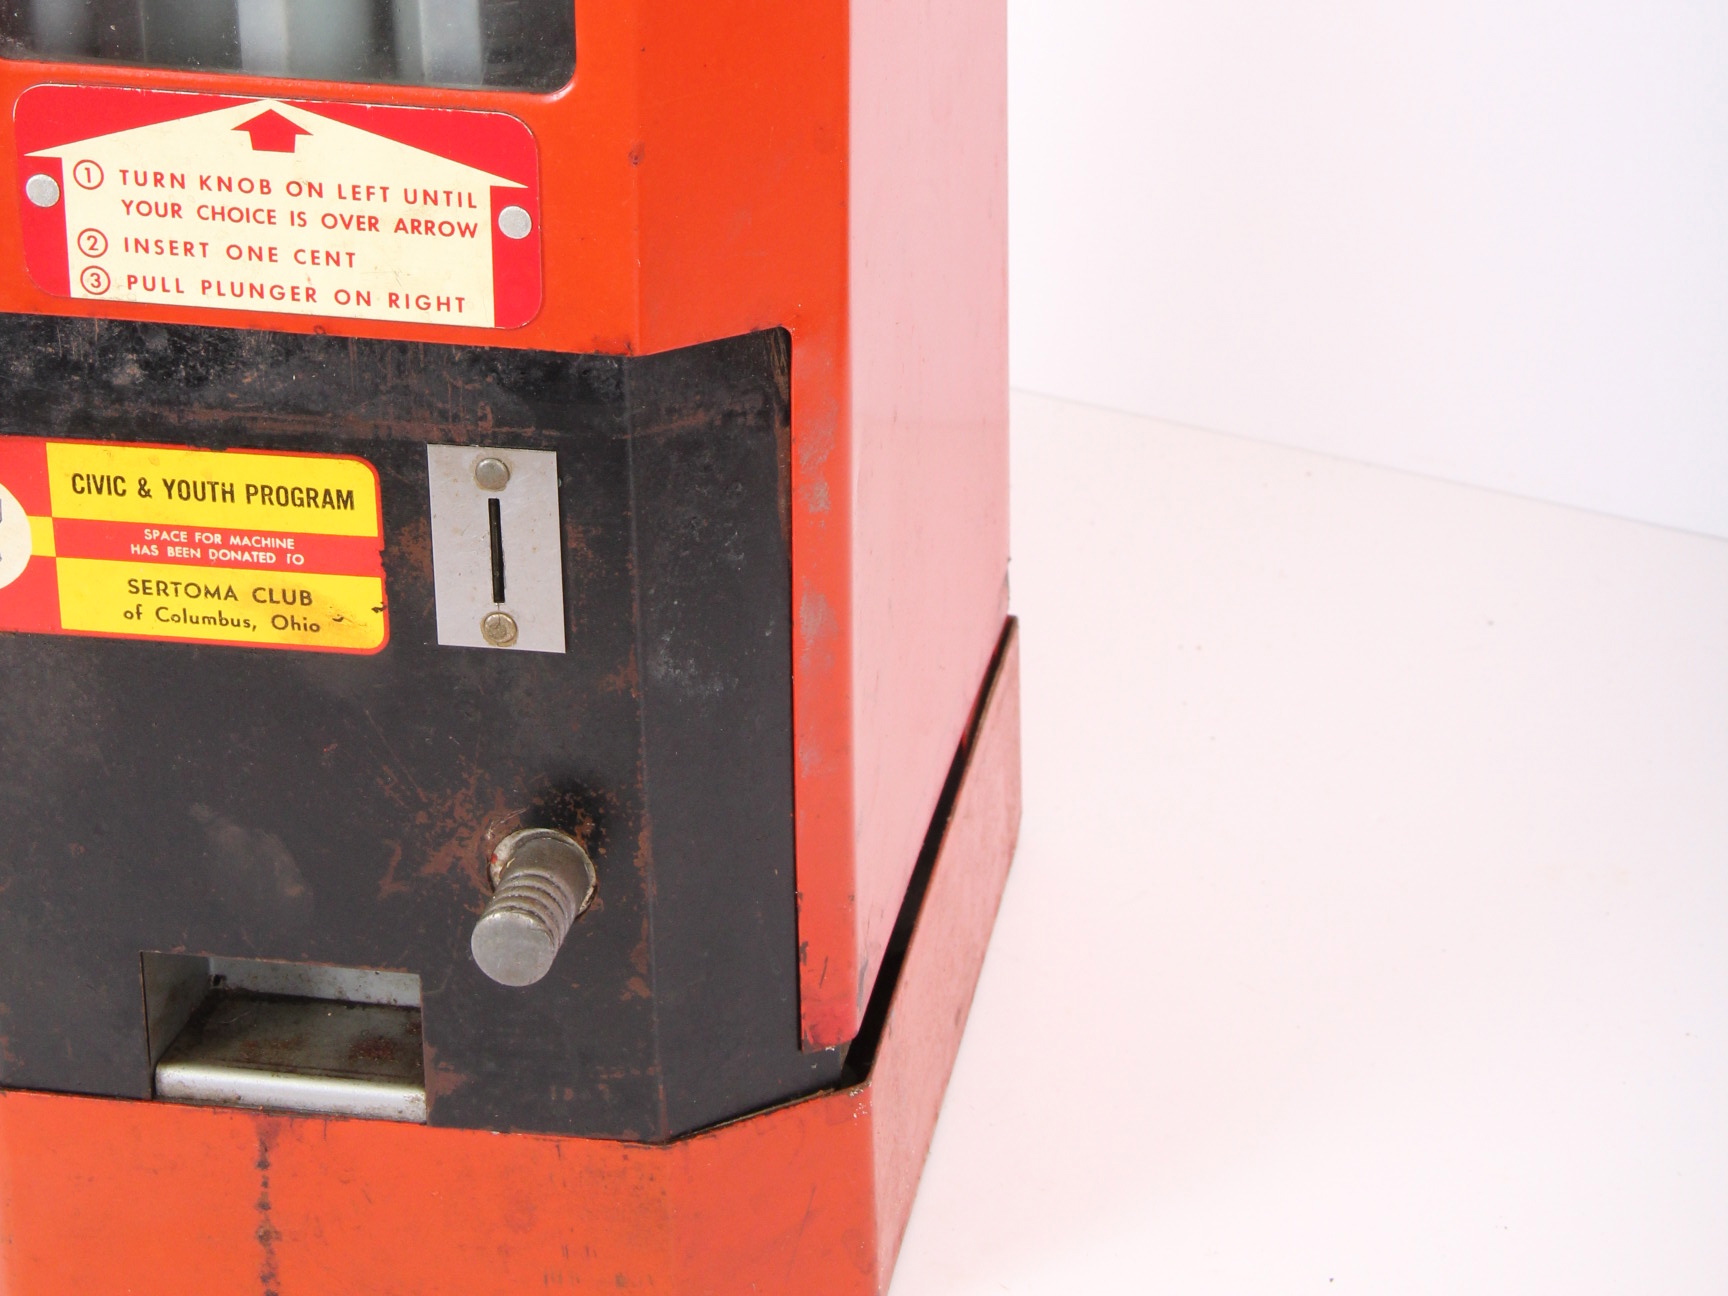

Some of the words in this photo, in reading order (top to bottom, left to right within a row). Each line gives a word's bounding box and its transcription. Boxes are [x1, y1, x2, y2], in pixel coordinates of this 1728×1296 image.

[119, 169, 186, 189] TURN
[199, 175, 272, 195] KNOB
[286, 180, 323, 198] ON
[337, 183, 390, 202] LEFT
[403, 187, 477, 208] UNTIL
[121, 200, 183, 219] YOUR
[197, 205, 277, 226] CHOICE
[290, 210, 307, 227] IS
[321, 212, 380, 232] OVER
[394, 217, 478, 238] ARROW
[124, 237, 208, 258] INSERT
[226, 243, 280, 262] ONE
[294, 249, 357, 268] CENT
[126, 274, 184, 294] PULL
[201, 281, 317, 303] PLUNGER
[334, 289, 372, 306] ON
[388, 293, 466, 313] RIGHT
[71, 473, 127, 497] CIVIC
[138, 477, 153, 498] &
[162, 479, 235, 504] YOUTH
[246, 484, 355, 511] PROGRAM
[130, 543, 159, 557] HAS
[165, 545, 201, 559] BEEN
[209, 548, 276, 564] DONATED
[286, 553, 305, 565] TO
[144, 528, 188, 543] SPACE
[195, 531, 222, 545] FOR
[229, 535, 295, 550] MACHINE
[128, 579, 238, 602] SERTOMA
[252, 587, 313, 606] CLUB
[123, 604, 142, 620] of
[155, 606, 257, 632] Columbus,
[271, 614, 320, 633] Ohio
